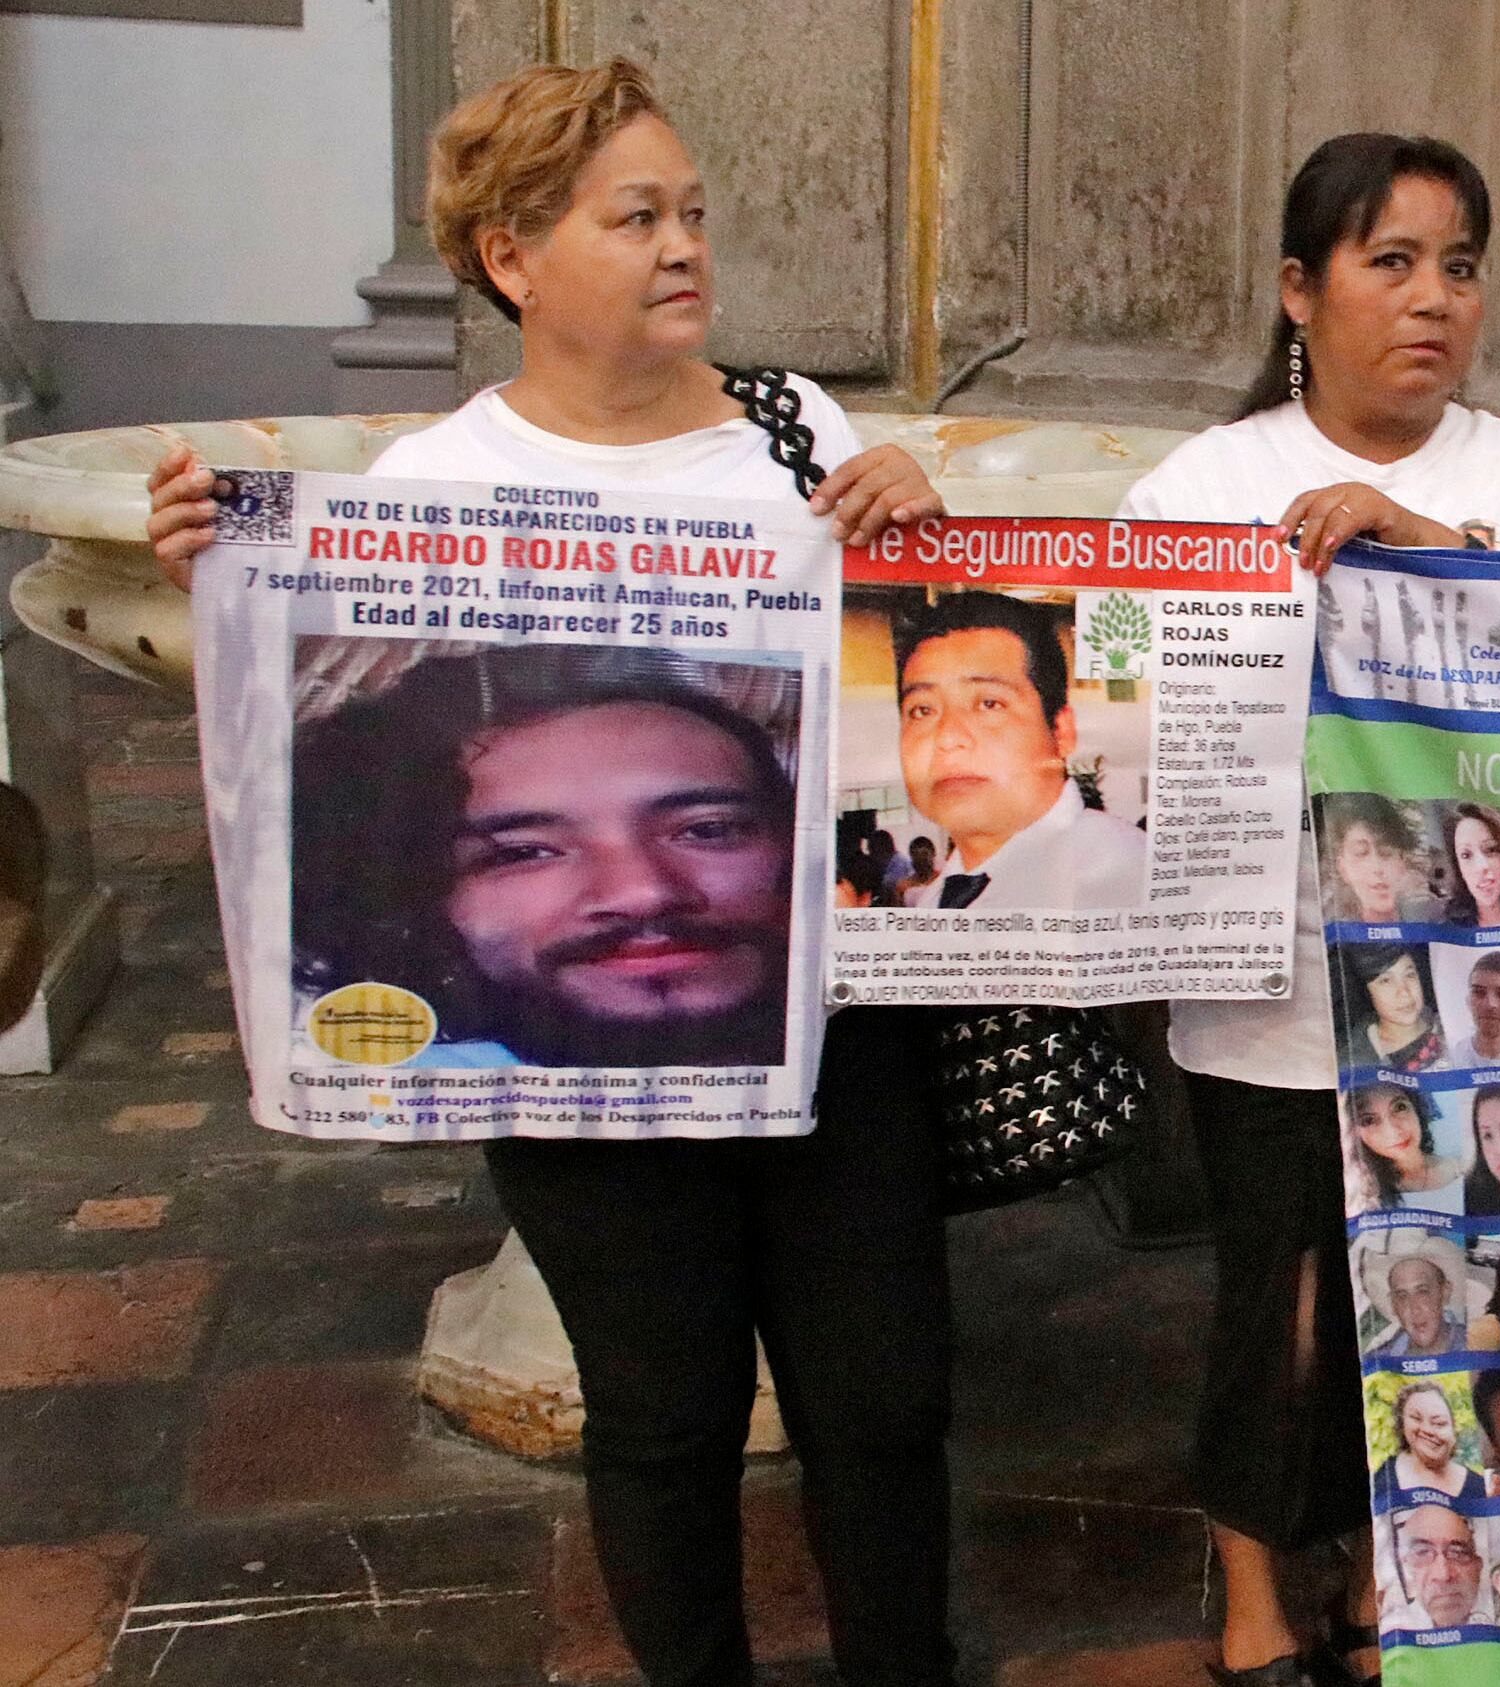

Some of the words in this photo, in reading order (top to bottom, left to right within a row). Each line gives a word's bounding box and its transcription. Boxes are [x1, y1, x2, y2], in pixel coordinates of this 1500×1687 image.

[494, 485, 600, 509] COLECTIVO
[326, 499, 369, 521] VOZ
[376, 502, 406, 523] DE
[411, 503, 454, 526] LOS
[460, 506, 638, 536] DESAPARECIDOS
[644, 517, 668, 538] EN
[675, 517, 756, 541] PUEBLA
[309, 526, 488, 568] RICARDO
[502, 535, 617, 574] ROJAS
[630, 541, 776, 581] GALAVIZ
[917, 519, 1095, 577] Seguimos
[1107, 524, 1280, 574] Buscando
[244, 566, 258, 589] 7
[267, 569, 414, 600] septiembre
[423, 575, 490, 601] 2021,
[498, 577, 607, 605] Infonavit
[746, 589, 822, 611] Puebla
[1162, 601, 1243, 617] CARLOS
[1252, 600, 1304, 617] RENÉ
[353, 602, 416, 628] Edad
[427, 605, 450, 628] al
[460, 607, 622, 638] desaparecer
[631, 613, 663, 636] 25
[670, 614, 729, 639] años
[1162, 627, 1229, 641] ROJAS
[1162, 650, 1284, 668] DOMÍNGUEZ
[1358, 659, 1392, 675] VOZ
[1395, 663, 1411, 678] de
[1414, 666, 1436, 681] los
[1205, 720, 1242, 733] Puebla
[1158, 739, 1190, 752] Edad:
[1194, 739, 1207, 752] 36
[1210, 740, 1236, 752] años
[1225, 774, 1267, 787] Robusta
[1181, 795, 1221, 807] Morena
[1155, 813, 1196, 827] Cabello
[1200, 811, 1241, 825] Castaño
[1242, 829, 1284, 844] grandes
[1187, 848, 1230, 860] Mediana
[1233, 863, 1264, 875] labios
[886, 912, 948, 932] Pantalon
[952, 913, 969, 932] de
[1041, 915, 1089, 934] camisa
[1129, 912, 1160, 929] tenis
[1164, 912, 1206, 931] negros
[1210, 912, 1219, 929] y
[1222, 910, 1255, 930] gorra
[1259, 907, 1283, 930] gris
[834, 951, 869, 963] Visto
[873, 952, 896, 966] por
[978, 951, 990, 961] el
[1014, 950, 1030, 961] de
[1034, 950, 1103, 963] Noviembre
[1108, 949, 1123, 960] de
[1164, 947, 1179, 956] en
[1182, 945, 1193, 954] la
[1197, 943, 1250, 955] terminal
[1254, 943, 1269, 954] de
[1273, 943, 1284, 954] la
[871, 967, 887, 977] de
[892, 966, 964, 977] autobuses
[968, 966, 1053, 977] coordinados
[1057, 968, 1073, 977] en
[1092, 962, 1135, 976] ciudad
[1138, 961, 1154, 972] de
[1158, 959, 1233, 972] Guadalajara
[1238, 958, 1284, 969] Jalisco
[290, 1072, 384, 1090] Cualquier
[391, 1073, 506, 1088] información
[512, 1073, 549, 1087] será
[557, 1073, 637, 1087] anónima
[644, 1078, 652, 1090] y
[659, 1073, 768, 1087] confidencial
[1377, 1070, 1419, 1089] GALILEA
[304, 1110, 331, 1123] 222
[416, 1112, 439, 1124] FB
[445, 1110, 520, 1123] Colectivo
[526, 1111, 551, 1122] voz
[557, 1111, 576, 1122] de
[581, 1111, 603, 1122] los
[608, 1109, 722, 1126] Desaparecidos
[727, 1112, 743, 1121] en
[750, 1109, 801, 1121] Puebla
[1389, 1213, 1452, 1228] GUADALUPE
[1411, 1492, 1450, 1506] SUSANA
[1415, 1630, 1461, 1645] EDUARDO
